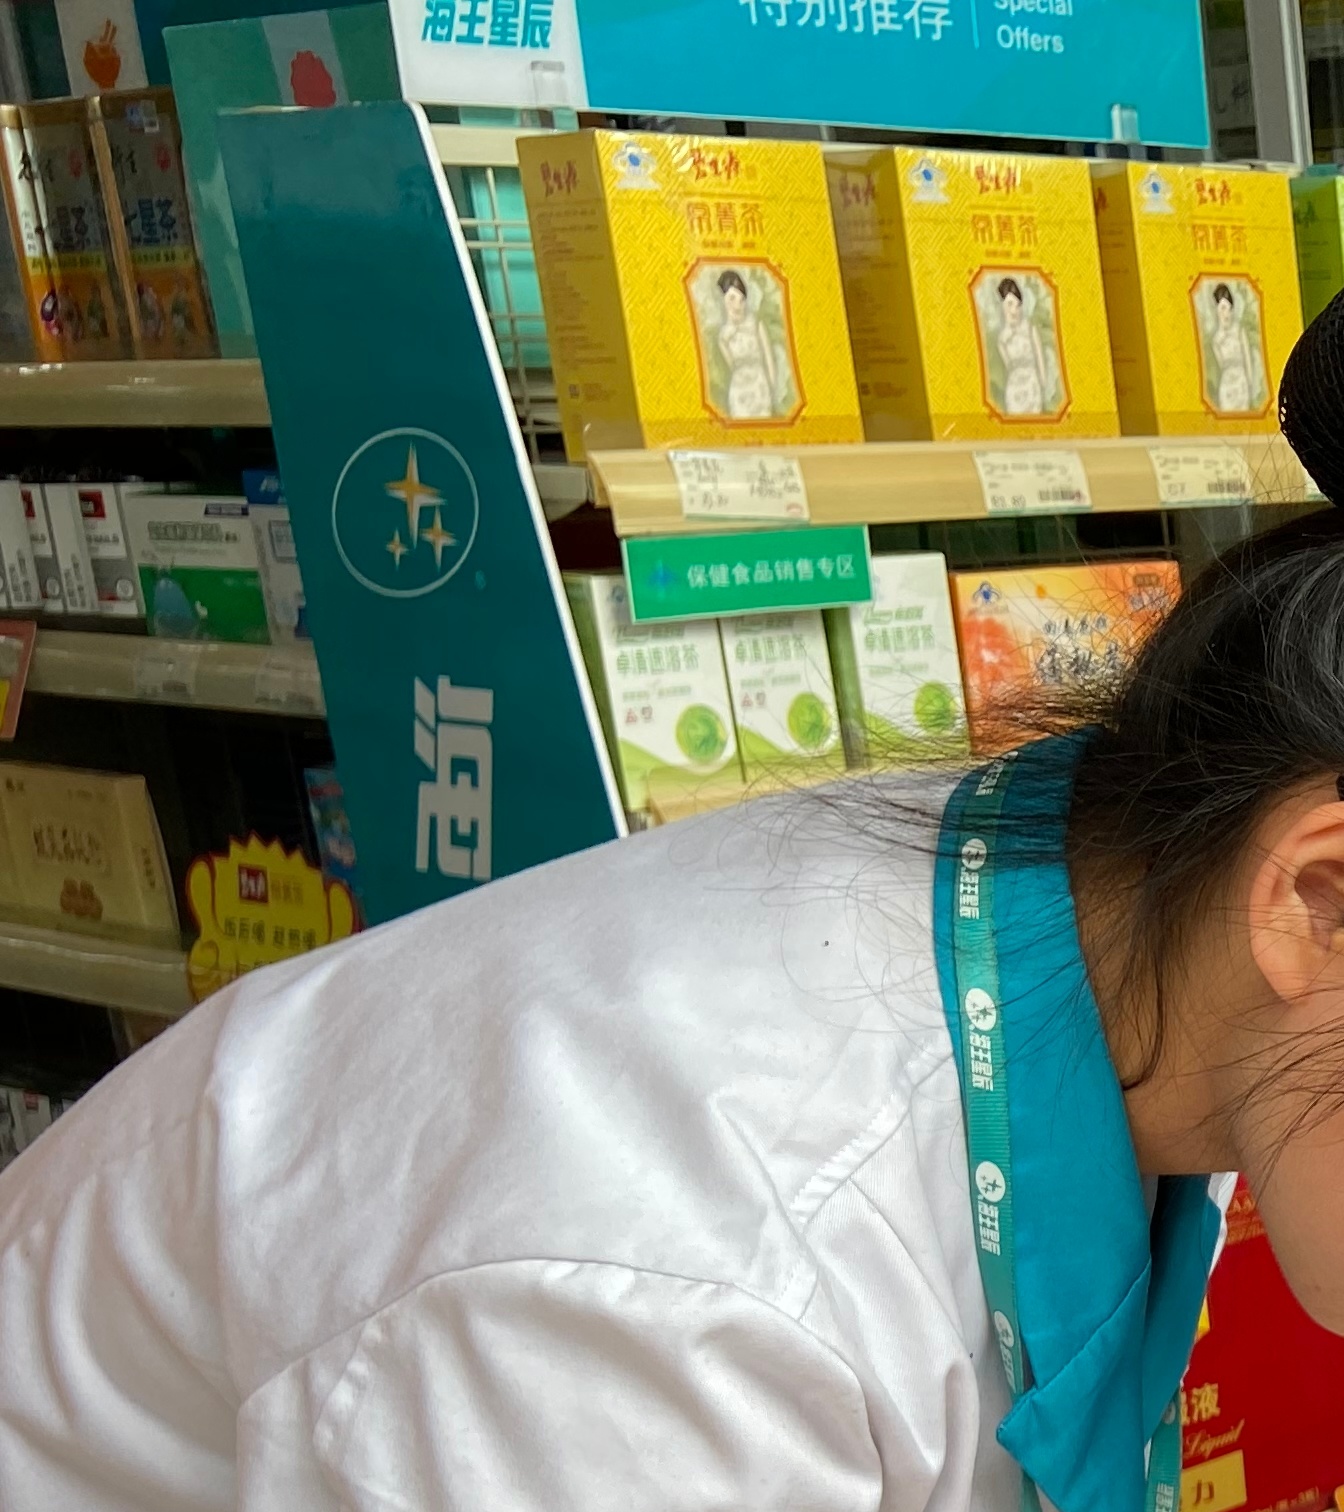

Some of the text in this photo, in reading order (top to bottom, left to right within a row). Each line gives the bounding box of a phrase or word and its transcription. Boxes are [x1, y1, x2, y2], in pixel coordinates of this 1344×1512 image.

[421, 0, 552, 48] 海王星辰
[997, 24, 1064, 54] Offers
[687, 554, 855, 589] 保健食品销售专区
